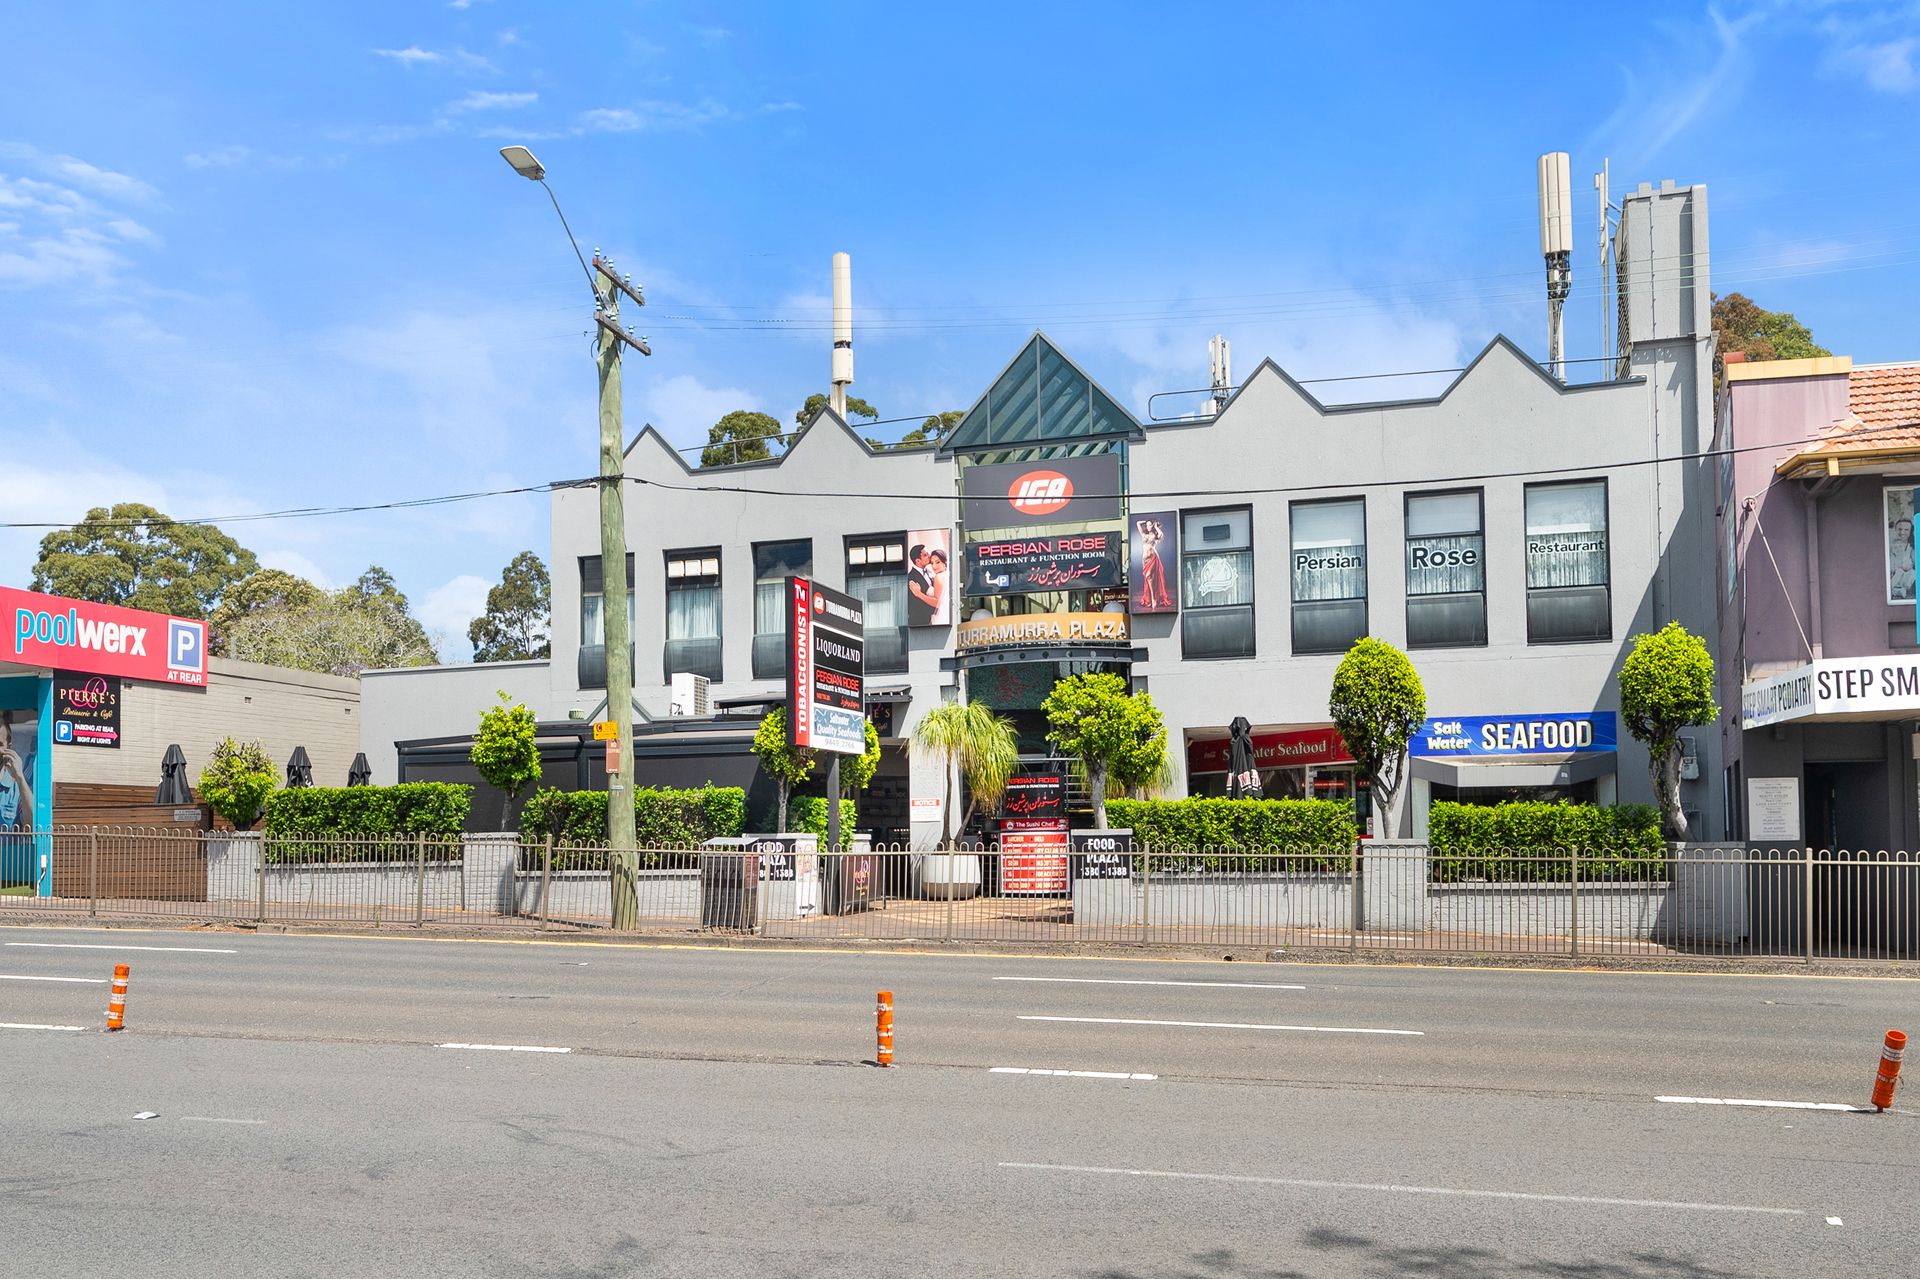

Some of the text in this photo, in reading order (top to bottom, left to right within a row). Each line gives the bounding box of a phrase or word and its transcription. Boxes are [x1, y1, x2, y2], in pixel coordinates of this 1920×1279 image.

[1014, 477, 1068, 507] IGA
[978, 536, 1106, 558] PERSIAN ROSE
[1529, 539, 1605, 553] Restaurant
[980, 556, 1028, 566] RESTAURANT
[1039, 552, 1081, 562] FUNCTION
[1082, 550, 1106, 559] ROOM
[1296, 552, 1362, 570] Persian
[1412, 547, 1477, 568] Rose
[15, 607, 147, 657] poolwerx
[957, 620, 1127, 643] TURRAMURRA PLAZA
[177, 629, 195, 661] P
[816, 637, 860, 663] LIQUORLAND
[167, 671, 202, 684] AT REAR
[797, 602, 807, 734] TOBACCONIST
[816, 669, 859, 690] PERSIAN ROSE
[1817, 666, 1919, 700] STEP SM
[60, 688, 116, 705] PIERRE'S
[1743, 675, 1812, 720] STEP SMART PODIATRY
[60, 723, 69, 737] P
[1433, 721, 1462, 735] Salt
[1481, 720, 1592, 750] SEAFOOD
[1277, 739, 1327, 756] Seafood
[1427, 736, 1472, 750] Water
[1088, 838, 1115, 850] FOOD
[1086, 853, 1120, 863] PLAZA
[1107, 867, 1127, 876] 1388
